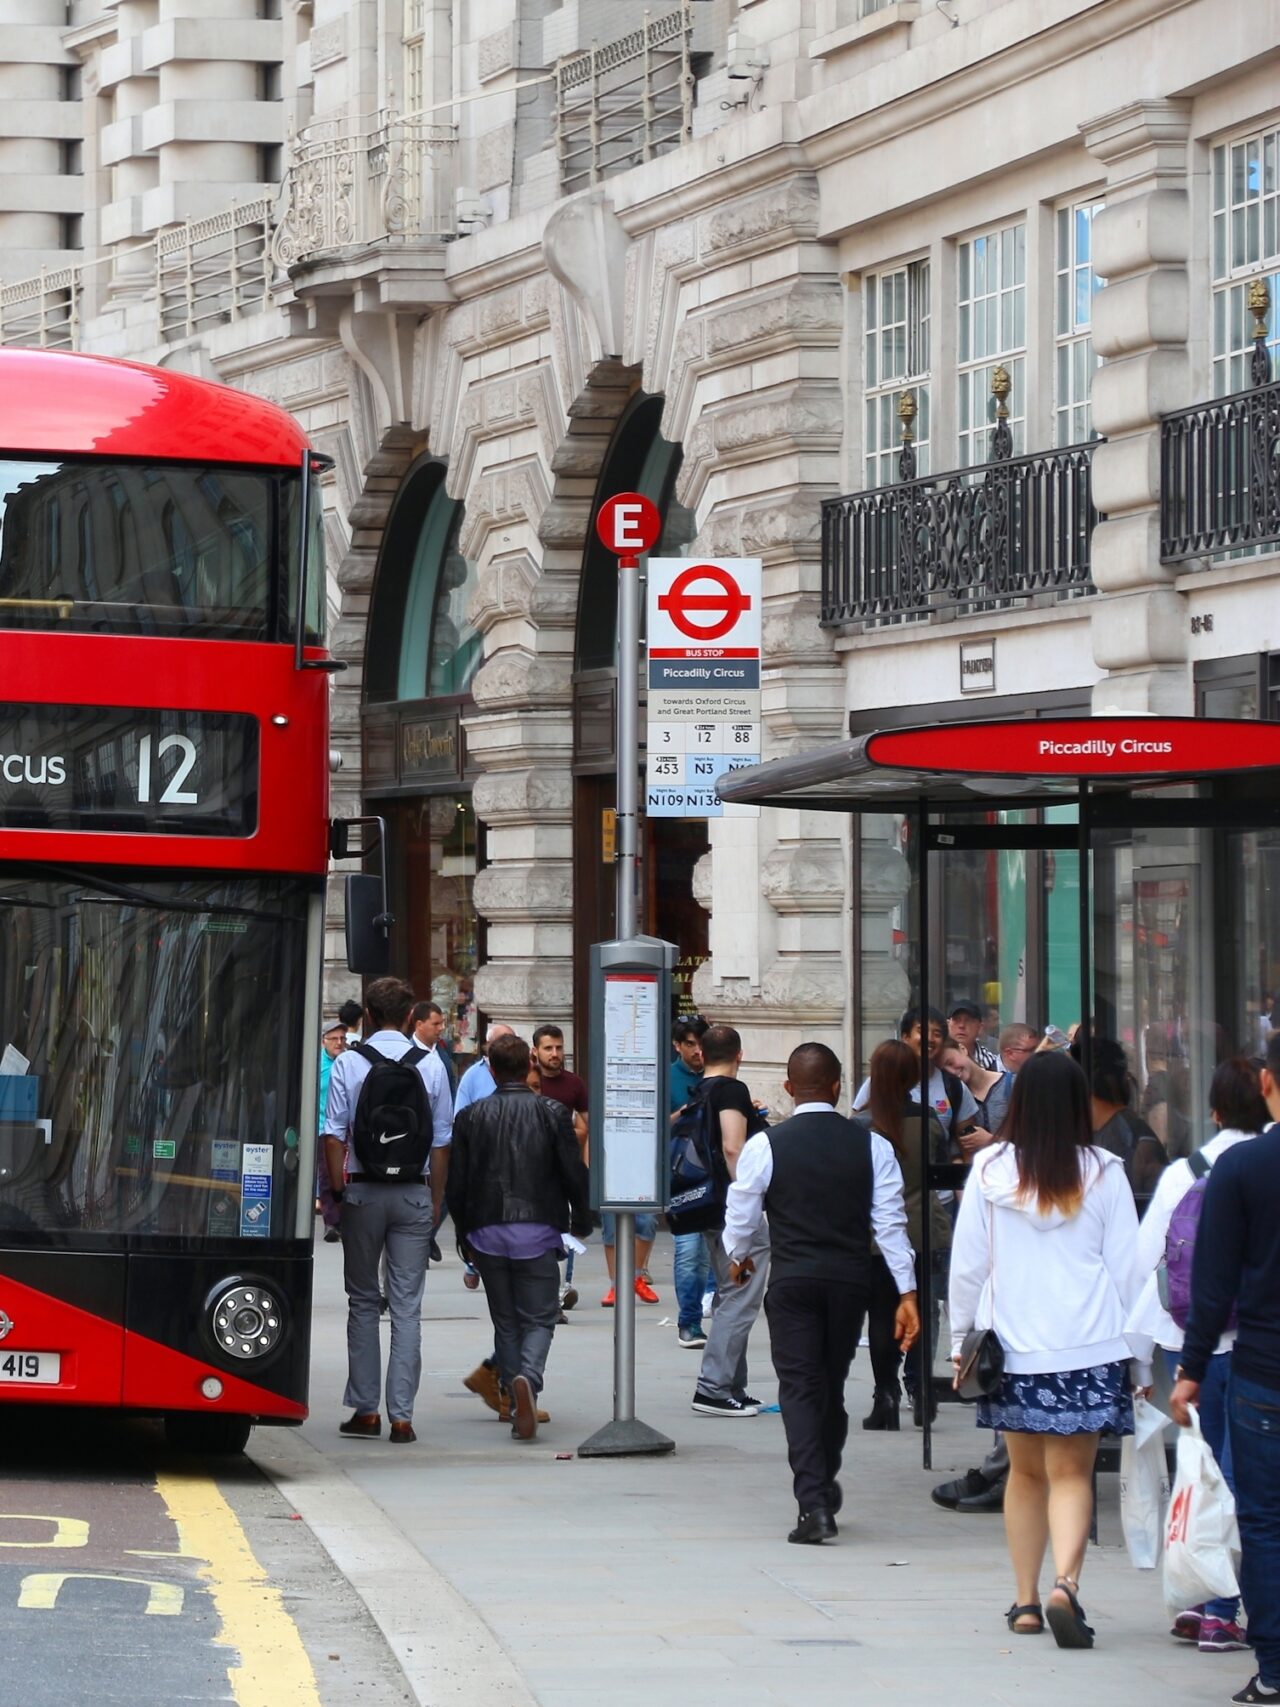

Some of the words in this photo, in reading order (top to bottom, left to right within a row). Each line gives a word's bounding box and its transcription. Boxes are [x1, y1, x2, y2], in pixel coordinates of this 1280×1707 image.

[614, 504, 643, 547] E
[663, 668, 711, 679] Piccadilly
[713, 668, 745, 678] Circus
[695, 697, 722, 705] Oxford
[663, 731, 671, 743] 3
[698, 731, 711, 743] 12
[734, 731, 750, 743] 88
[1039, 740, 1116, 757] Piccadilly
[1120, 739, 1172, 753] Circus
[136, 733, 199, 805] 12
[655, 763, 679, 775] 453
[695, 763, 714, 774] N3
[648, 795, 684, 806] N109
